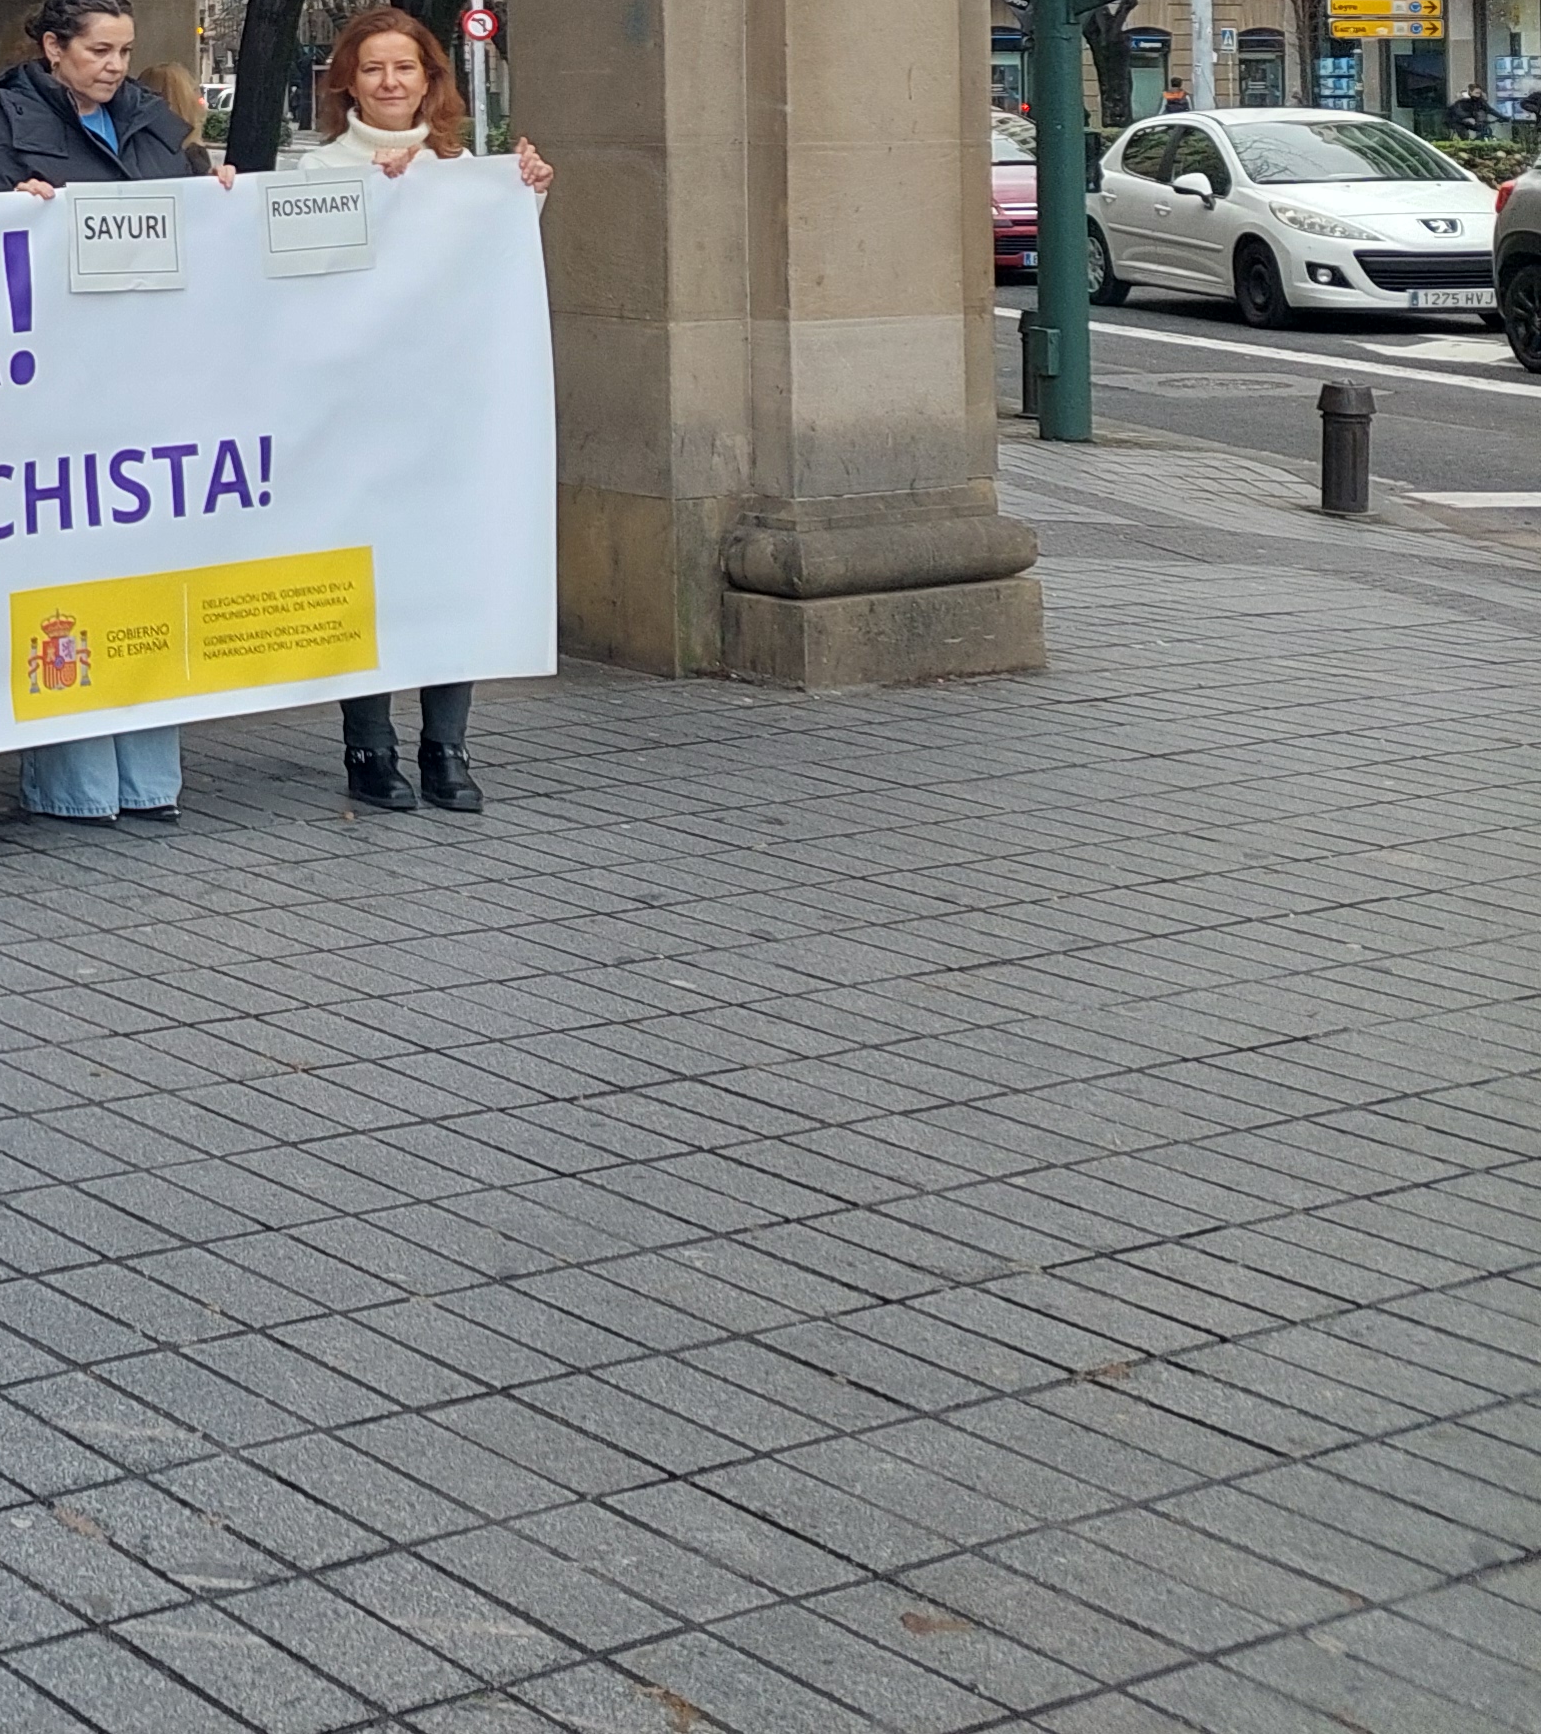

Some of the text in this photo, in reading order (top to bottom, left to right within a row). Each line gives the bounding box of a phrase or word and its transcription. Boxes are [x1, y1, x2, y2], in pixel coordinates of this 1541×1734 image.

[272, 194, 360, 217] ROSSMARY
[83, 213, 167, 242] SAYURI
[1423, 292, 1494, 305] 1275 HVJ
[262, 591, 277, 602] DEL
[280, 584, 327, 599] GOBIERNO
[329, 582, 341, 593] EN
[343, 581, 354, 591] LA
[203, 608, 260, 624] COMUNIDAD
[294, 601, 304, 611] DE
[107, 623, 169, 643] GOBIERNO
[107, 638, 169, 658] DE ESPAÑA
